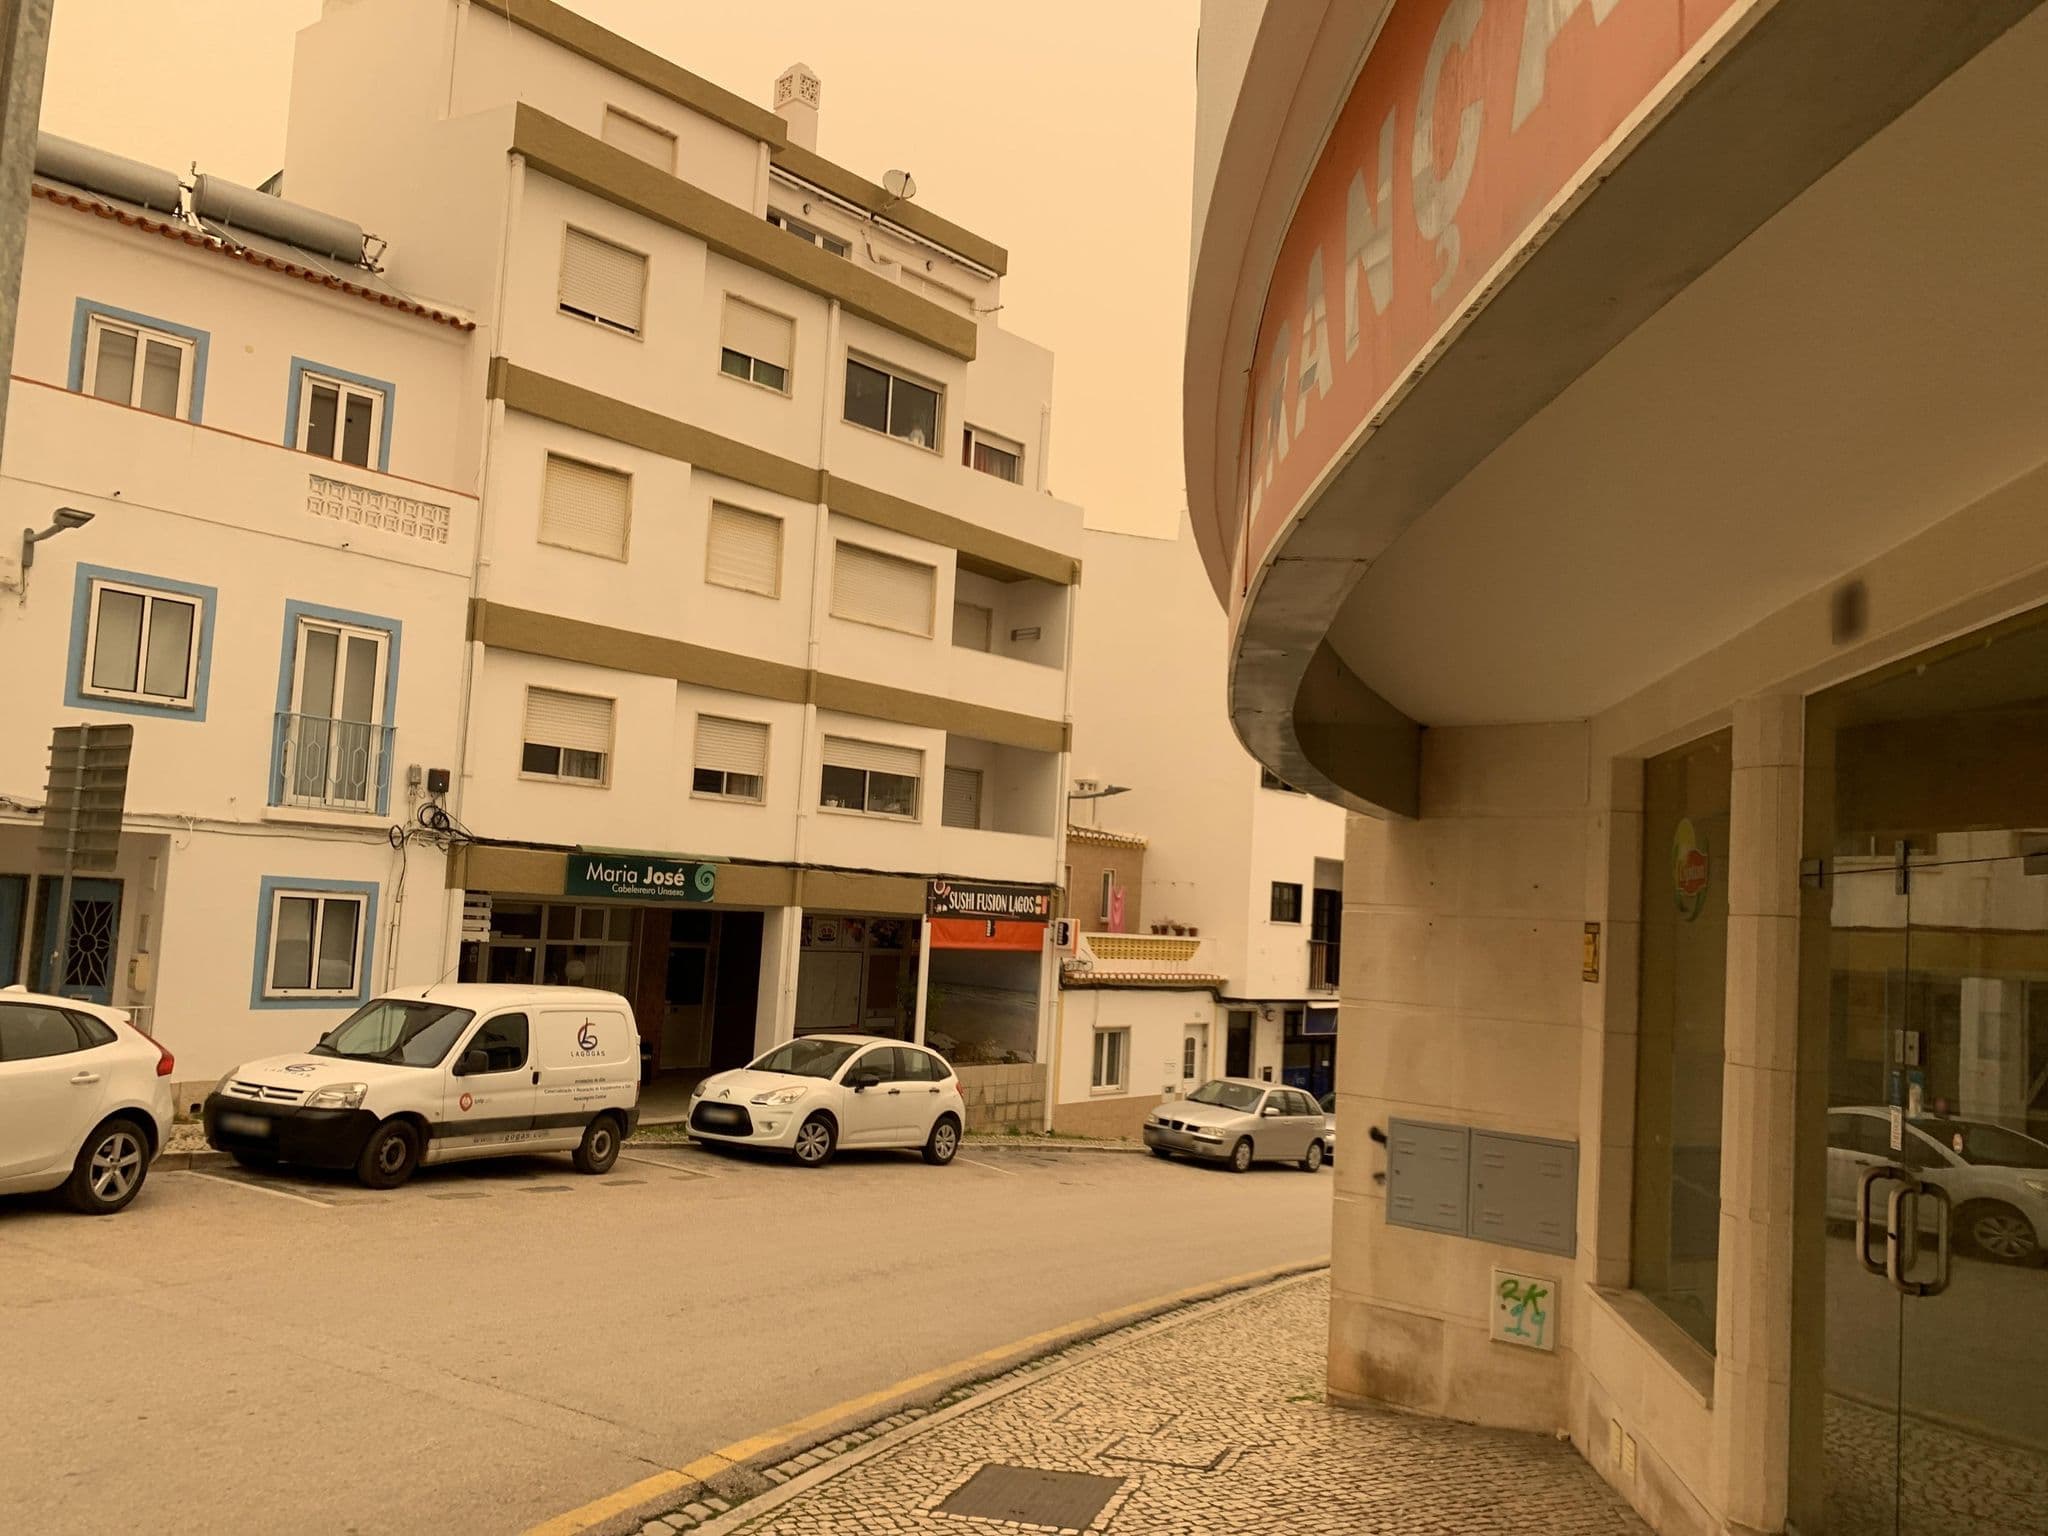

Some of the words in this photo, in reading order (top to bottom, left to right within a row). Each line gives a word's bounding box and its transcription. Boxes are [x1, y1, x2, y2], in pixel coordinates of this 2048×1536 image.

[586, 862, 638, 883] Maria
[643, 867, 685, 886] José
[611, 883, 656, 895] Cabeleireiro
[949, 891, 975, 910] SUSHI
[976, 893, 1007, 912] FUSION
[1009, 895, 1034, 914] LAGOS
[1500, 1279, 1548, 1315] 2K
